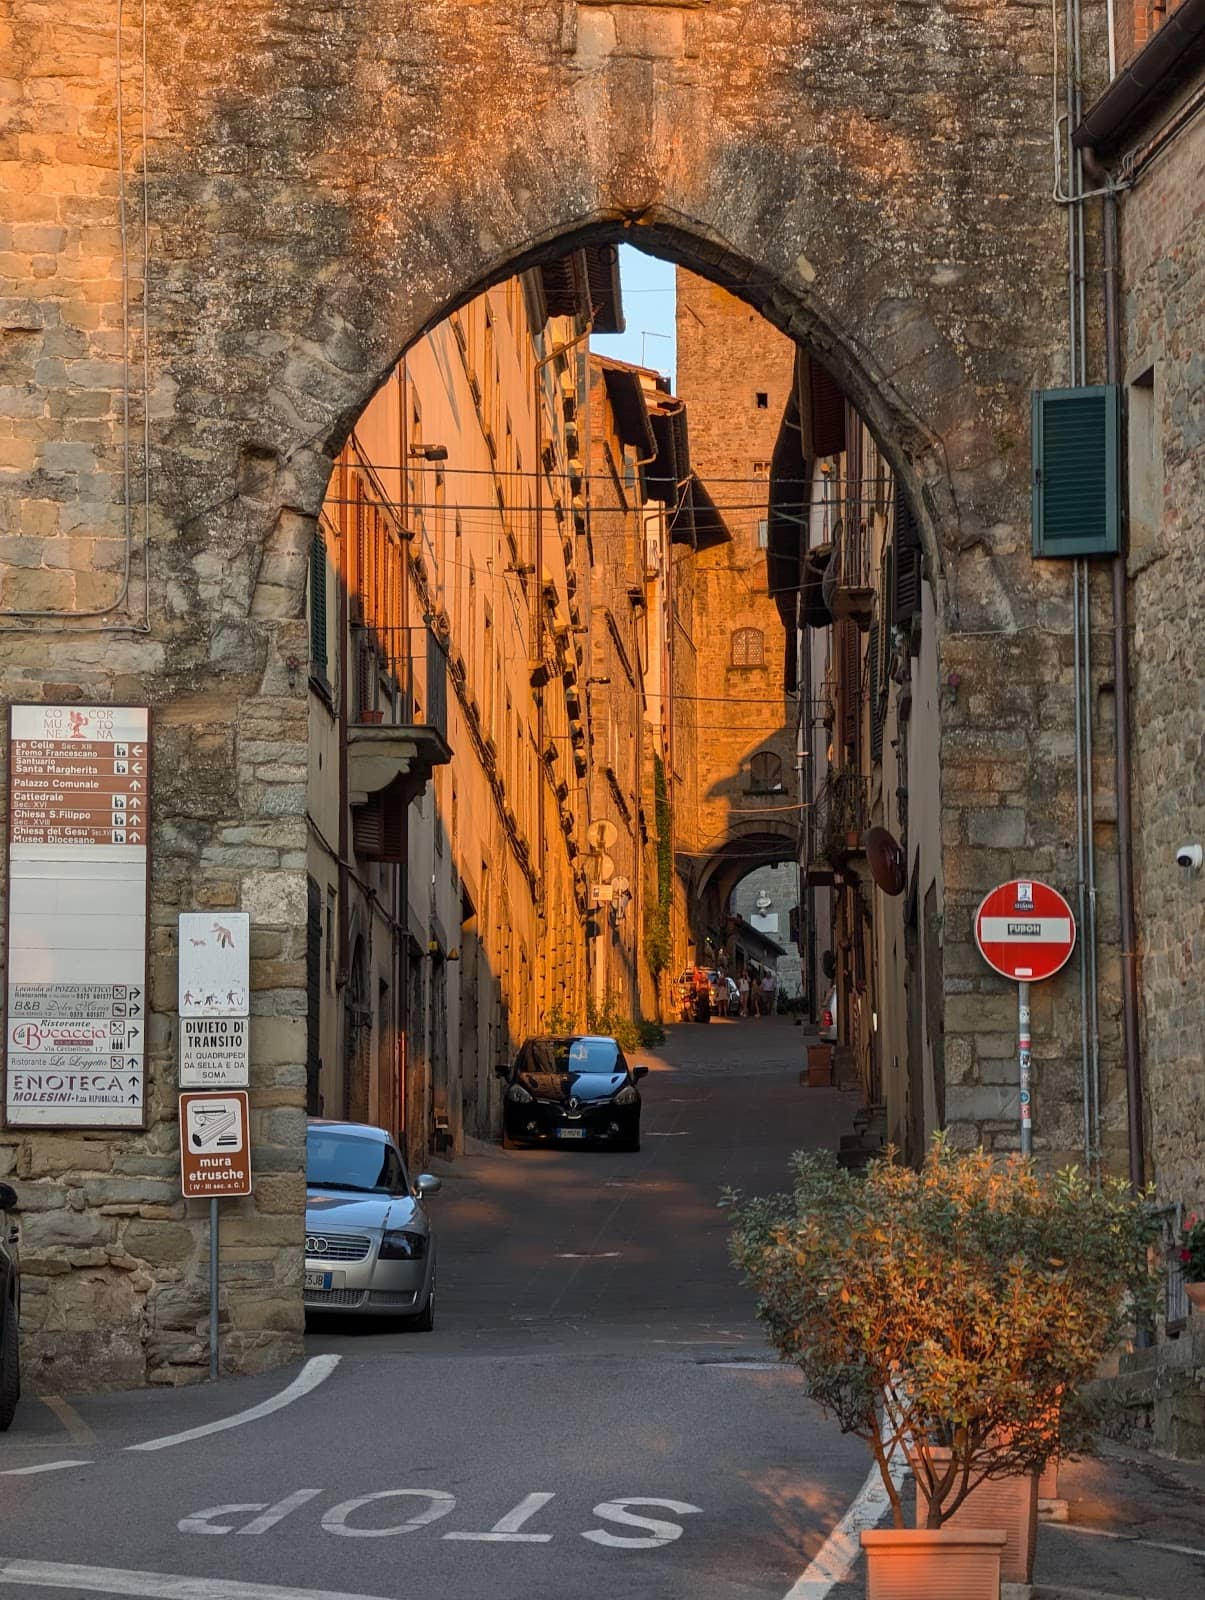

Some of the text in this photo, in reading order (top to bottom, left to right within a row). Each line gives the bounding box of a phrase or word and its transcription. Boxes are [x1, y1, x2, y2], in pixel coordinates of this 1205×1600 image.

[45, 710, 62, 718] CO
[89, 710, 113, 719] COR
[44, 719, 62, 728] MU
[97, 720, 113, 729] TO
[47, 729, 62, 738] NE
[97, 730, 113, 739] NA
[31, 741, 54, 749] Celle
[16, 765, 97, 775] Santa Margherita
[14, 779, 99, 788] Palazzo Comunale
[14, 793, 64, 801] Cattedrale
[15, 810, 45, 818] Chiesa
[14, 827, 44, 835] Chiesa
[48, 836, 95, 844] Diocesano
[14, 1001, 40, 1010] B&B
[186, 1021, 244, 1033] DIVIETO DI
[13, 1023, 106, 1051] Bucaccia
[188, 1036, 242, 1047] TRANSITO
[196, 1051, 245, 1059] QUADRUPEDI
[11, 1058, 46, 1066] Ristorante
[202, 1071, 226, 1079] SOMA
[14, 1075, 123, 1091] ENOTECA
[13, 1092, 72, 1102] MOLESINI
[200, 1158, 232, 1167] mura
[189, 1169, 244, 1181] etrusche
[177, 1487, 705, 1549] STOP
